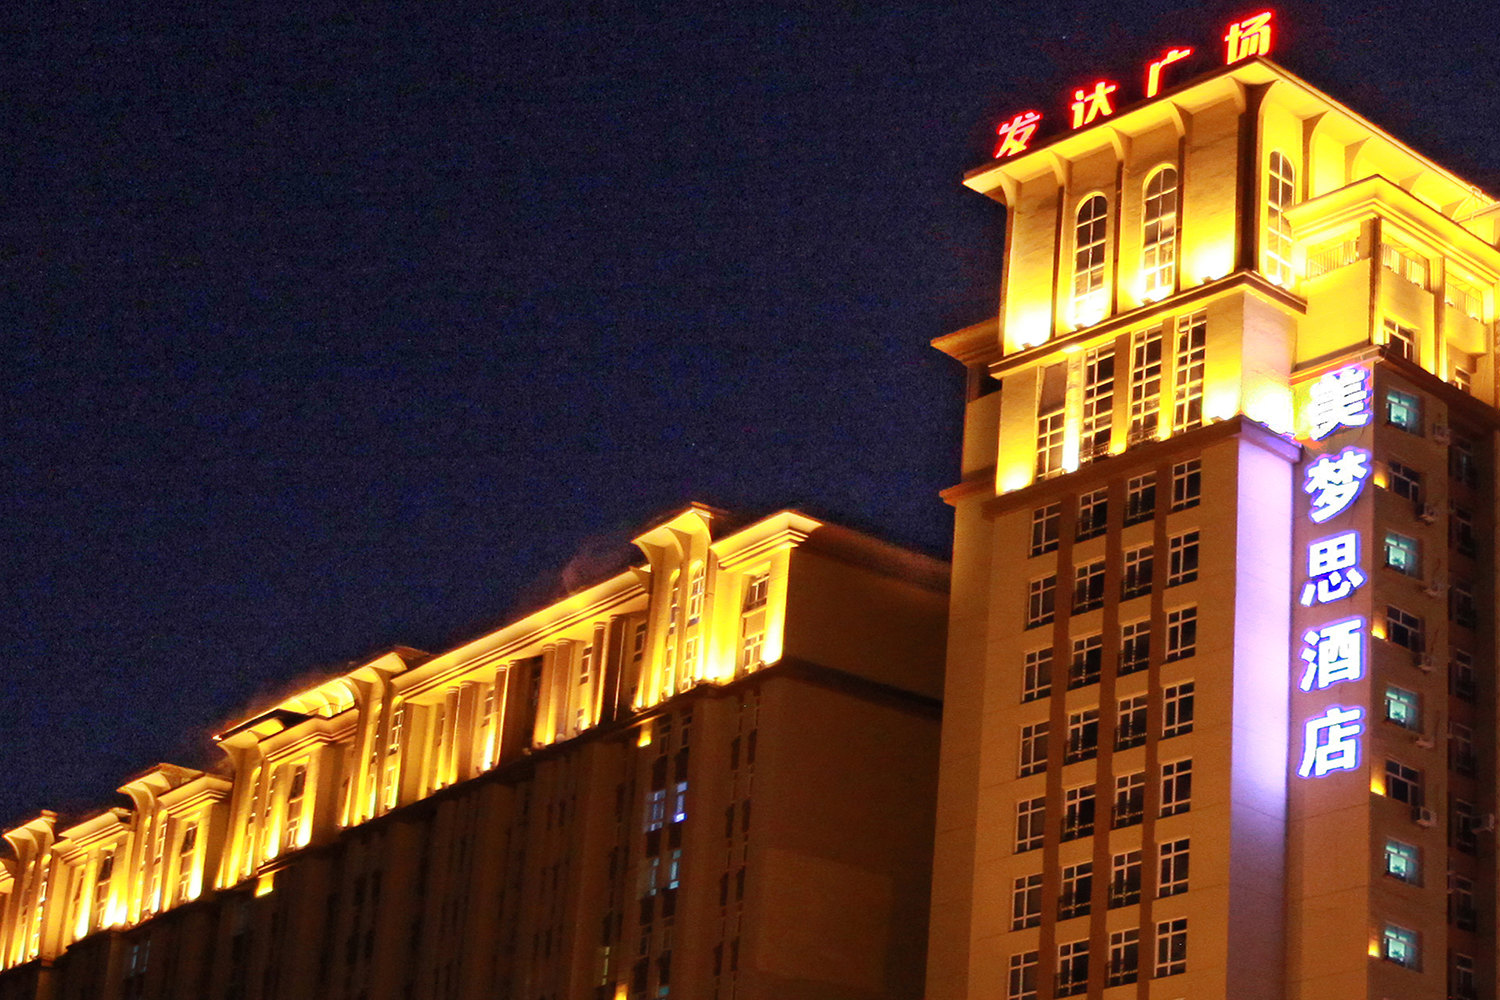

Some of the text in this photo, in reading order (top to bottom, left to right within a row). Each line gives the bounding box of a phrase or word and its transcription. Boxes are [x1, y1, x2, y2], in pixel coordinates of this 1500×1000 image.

[1298, 367, 1369, 778] 美梦思酒店
